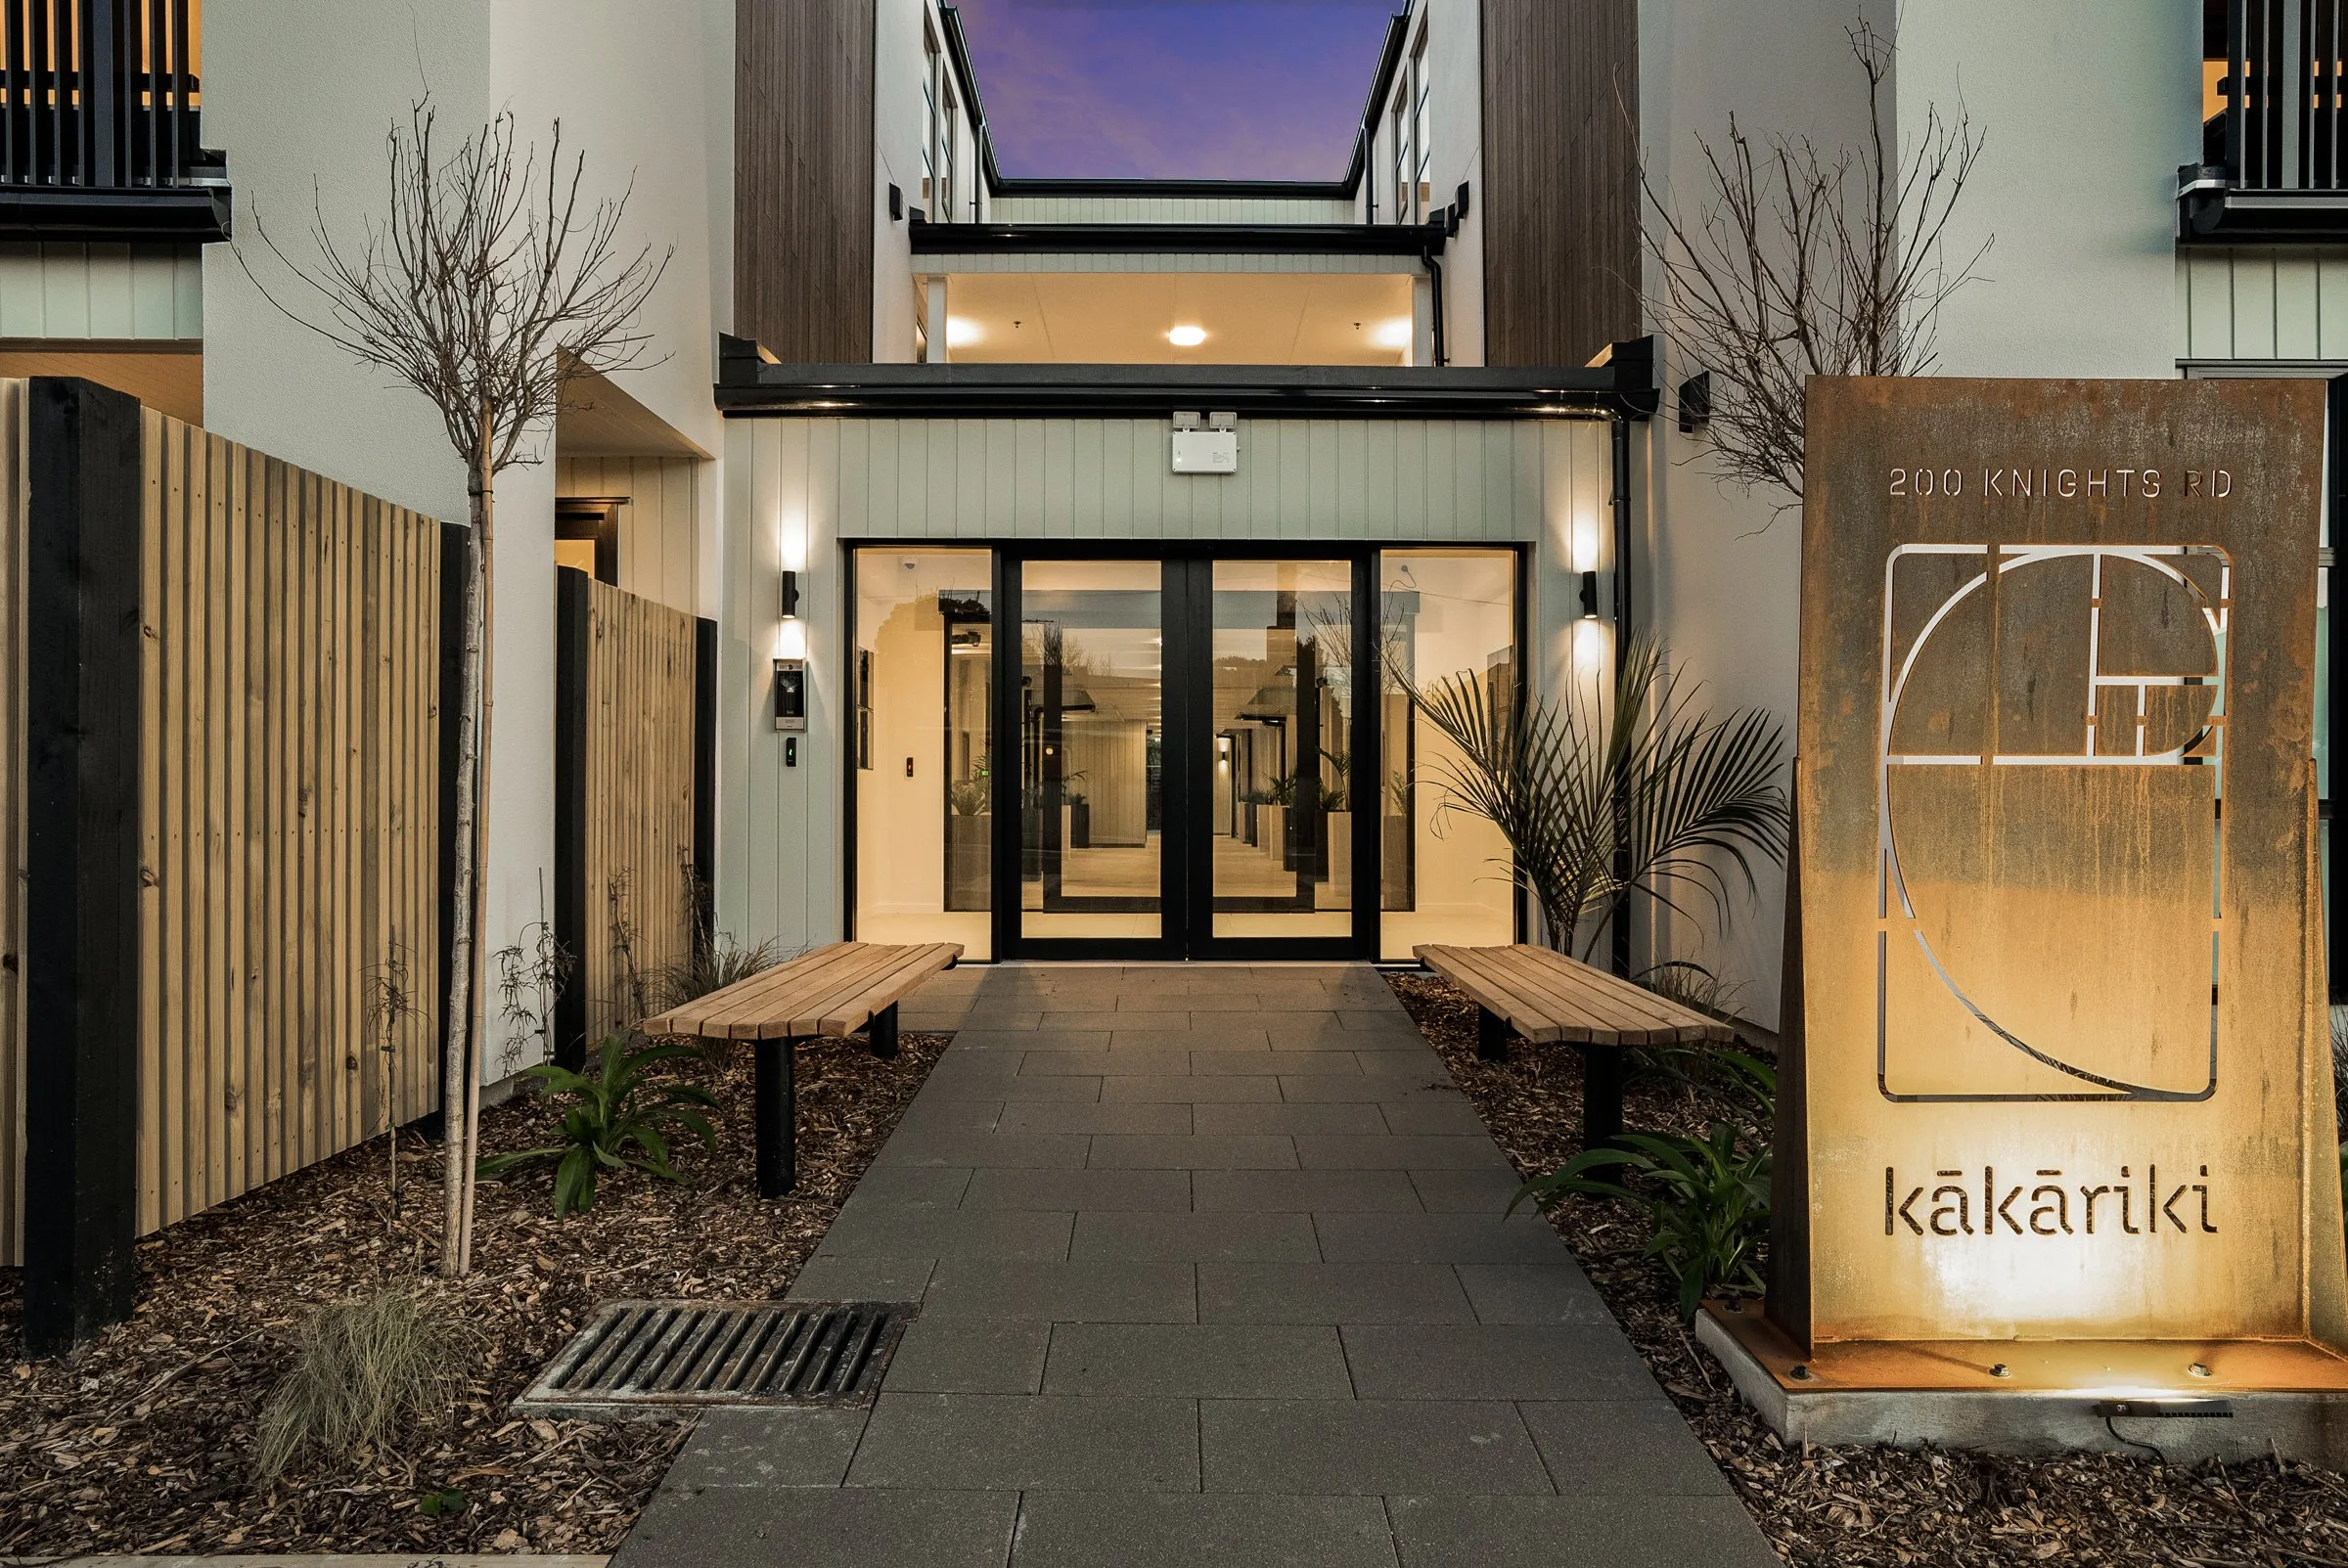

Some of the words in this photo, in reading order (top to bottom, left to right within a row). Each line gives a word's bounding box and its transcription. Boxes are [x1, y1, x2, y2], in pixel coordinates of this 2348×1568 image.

[1889, 468, 1963, 496] 200
[1985, 469, 2161, 497] KNIGHTS
[2186, 470, 2232, 498] RD
[1884, 1164, 2218, 1235] kākāriki
